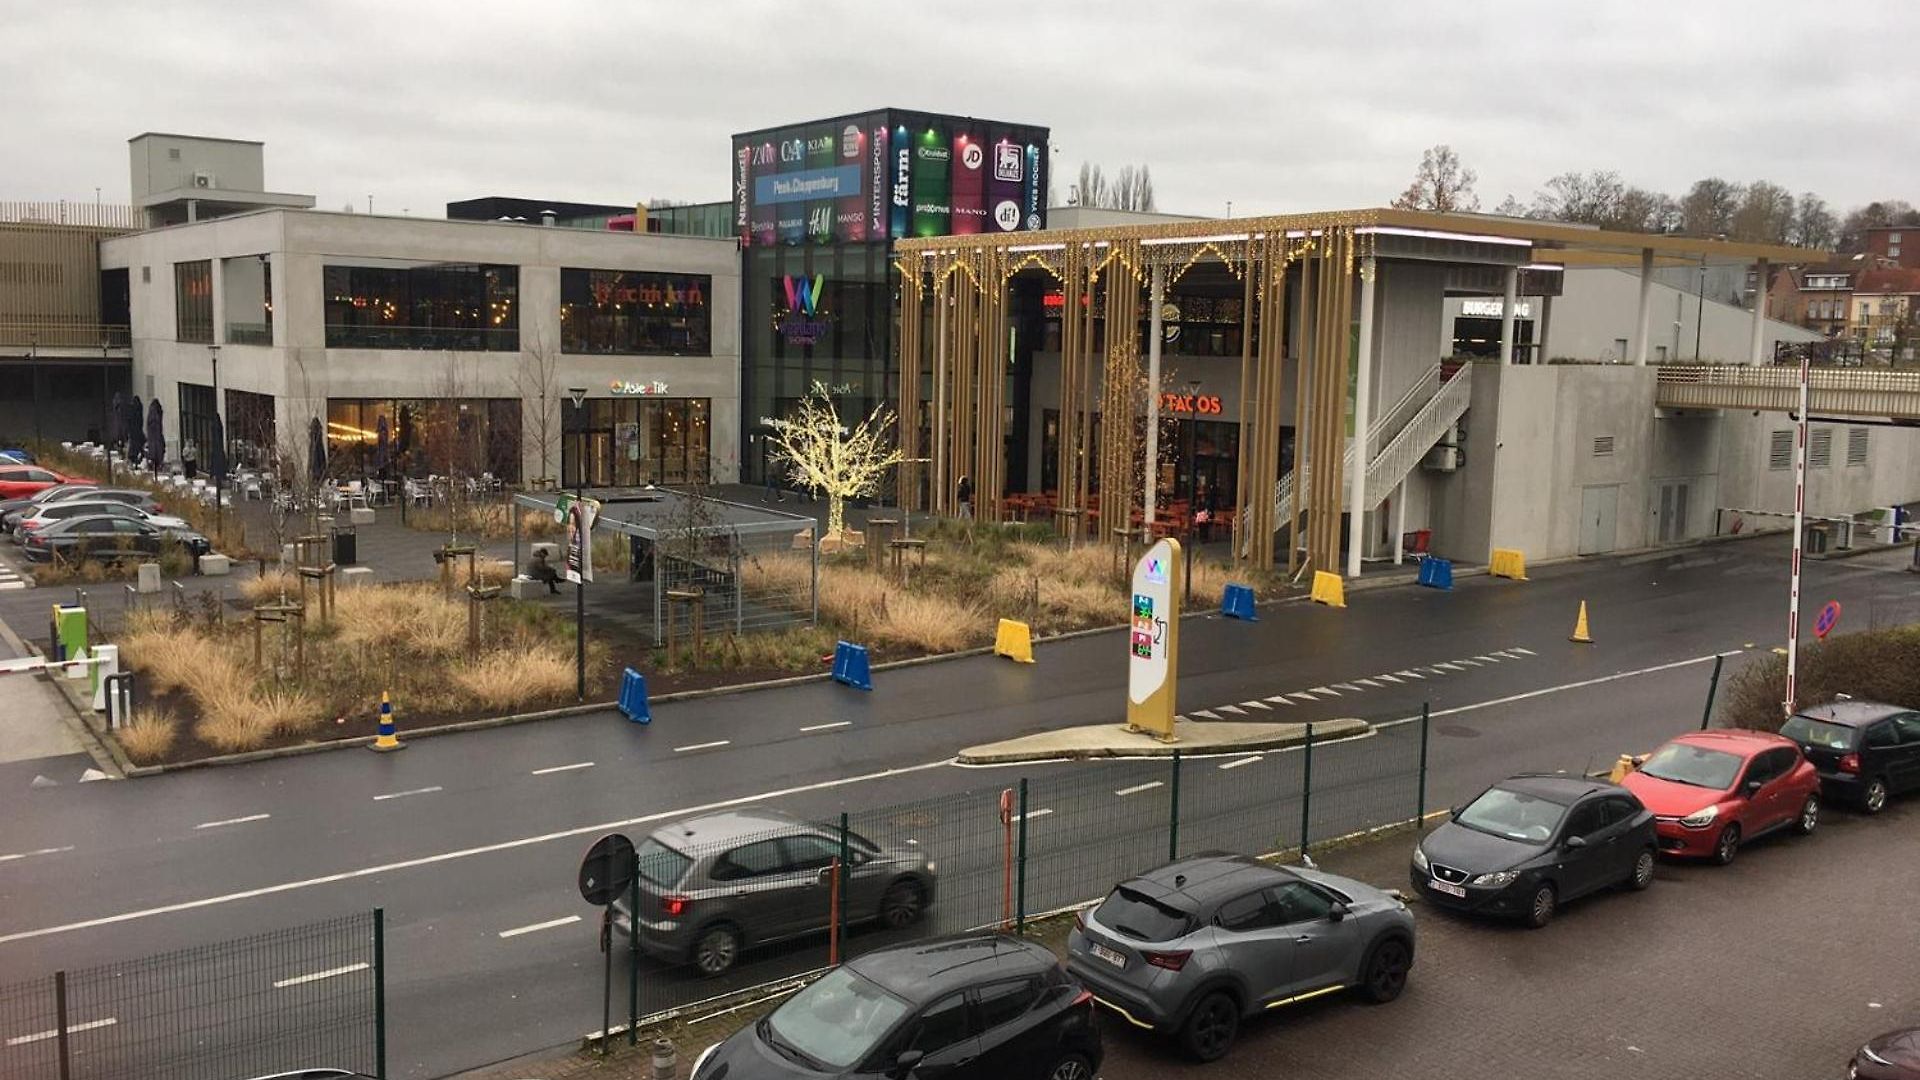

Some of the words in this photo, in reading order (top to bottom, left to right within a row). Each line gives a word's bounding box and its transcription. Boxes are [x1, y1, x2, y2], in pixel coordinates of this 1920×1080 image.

[873, 128, 881, 217] INTERSPORT
[966, 150, 980, 163] JD
[893, 149, 910, 206] färm
[1462, 301, 1504, 316] BURGER
